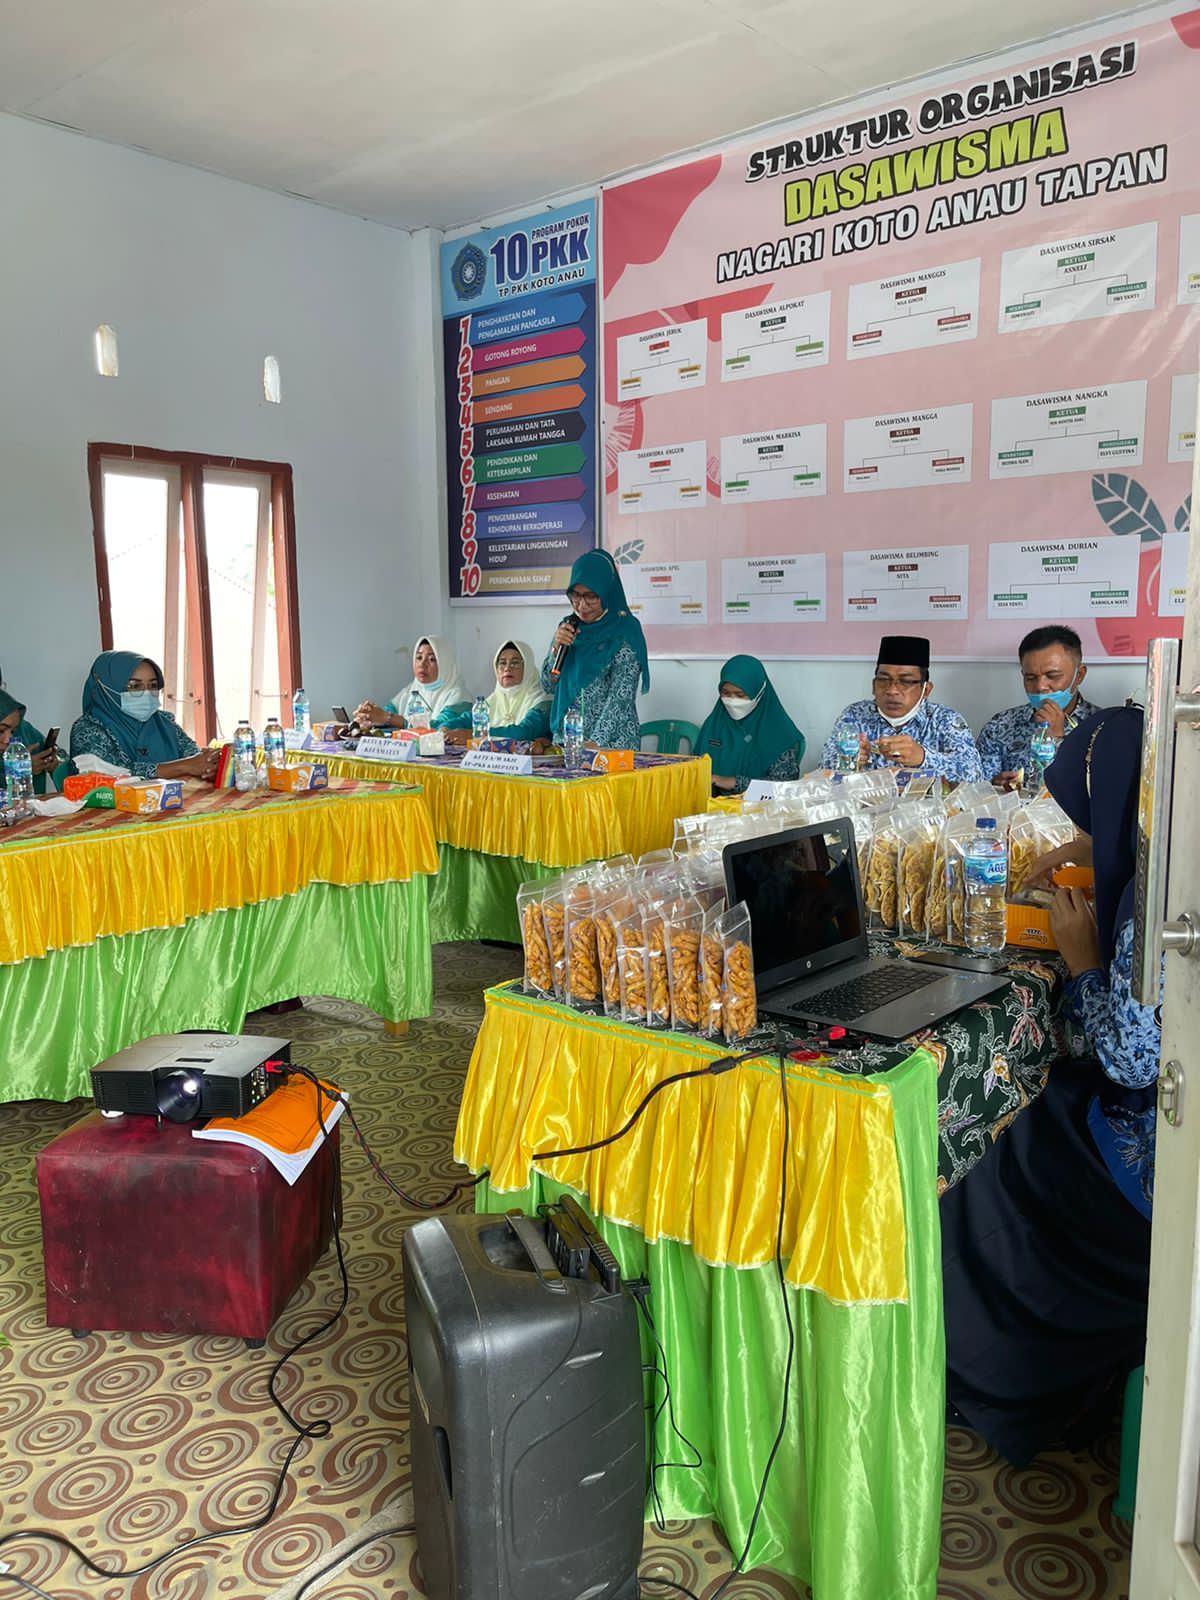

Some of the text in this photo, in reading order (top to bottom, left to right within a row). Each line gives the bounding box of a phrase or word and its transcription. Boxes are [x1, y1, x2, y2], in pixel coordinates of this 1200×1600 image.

[746, 41, 1137, 181] STRUKTUR ORGANISASI
[784, 107, 1067, 225] DASAWISMA
[717, 145, 1168, 282] NAGARI KOTO ANAU TAPAN
[531, 214, 589, 240] PROGRAM POKOK
[490, 232, 528, 285] 10
[531, 228, 589, 274] PKK
[1039, 234, 1117, 257] DASAWISMA SIRSAK
[1064, 255, 1088, 265] KETUA
[498, 268, 586, 297] TP PKK KOTO ANAU
[880, 269, 947, 290] DASAWISMA MANGGIS
[522, 308, 536, 319] DAN
[459, 315, 472, 346] 1
[478, 315, 556, 340] PENGAMALAN PANCASILA
[459, 347, 472, 375] 2
[484, 343, 537, 362] GOTONG ROYONG
[459, 376, 472, 403] 3
[485, 376, 511, 388] PANGAN
[1026, 389, 1109, 408] DASAWISMA NANGKA
[460, 403, 472, 428] 4
[875, 412, 939, 427] DASAWISMA MANGGA
[1055, 408, 1079, 417] KETUA
[486, 418, 556, 436] PERUMAHAN DAN TATA
[486, 428, 566, 448] LAKSANA RUMAH TANGGA
[461, 428, 473, 457] 5
[523, 453, 538, 464] DAN
[461, 457, 474, 486] 6
[486, 465, 532, 479] KETERAMPILAN
[463, 484, 476, 512] 7
[487, 490, 520, 501] KESEHATAN
[462, 512, 476, 540] 8
[487, 511, 538, 523] PENGEMBANGAN
[463, 540, 476, 565] 9
[488, 539, 569, 553] KELESTARIAN LINGKUNGAN
[870, 550, 939, 561] DASAWISMA BELIMBING
[1020, 542, 1099, 553] DASAWISMA DURIAN
[462, 565, 480, 596] 10
